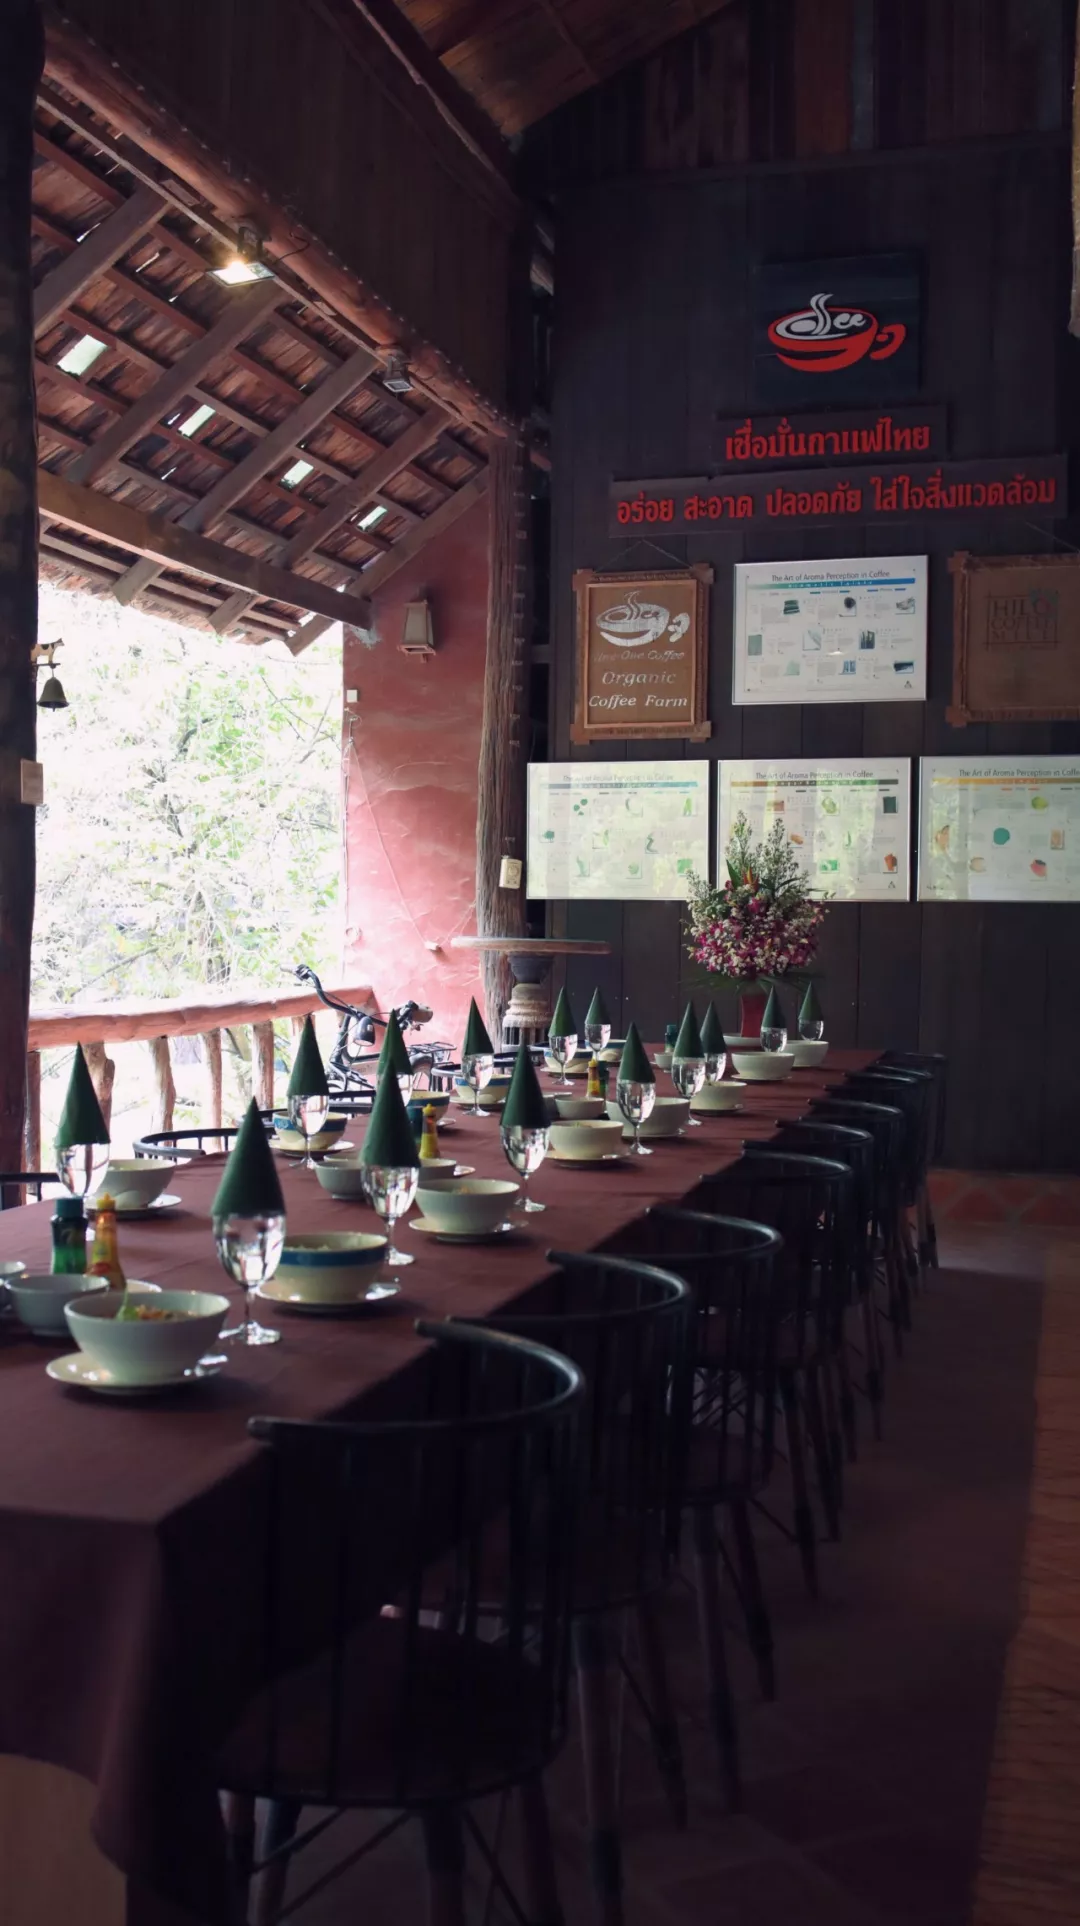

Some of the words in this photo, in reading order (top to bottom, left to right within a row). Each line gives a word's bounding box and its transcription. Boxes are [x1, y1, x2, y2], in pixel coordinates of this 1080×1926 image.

[725, 417, 930, 460] เชื่อมั่นกาแฟไทย
[617, 491, 674, 525] อร่อย
[684, 494, 753, 521] สะอาด
[766, 482, 862, 517] ปลอดภัย
[870, 469, 1056, 512] ใส่ใจสิ่งแวดล้อม
[796, 573, 802, 581] of
[803, 573, 825, 581] Aroma
[826, 571, 860, 581] Perception
[868, 570, 890, 578] Coffee
[602, 671, 677, 687] Organic
[589, 693, 636, 710] Coffee
[645, 694, 688, 707] Farm
[959, 769, 970, 777] The
[972, 769, 982, 777] Art
[983, 769, 991, 777] of
[993, 769, 1015, 777] Aroma
[1016, 769, 1052, 778] Perception
[1061, 768, 1080, 777] Coffe
